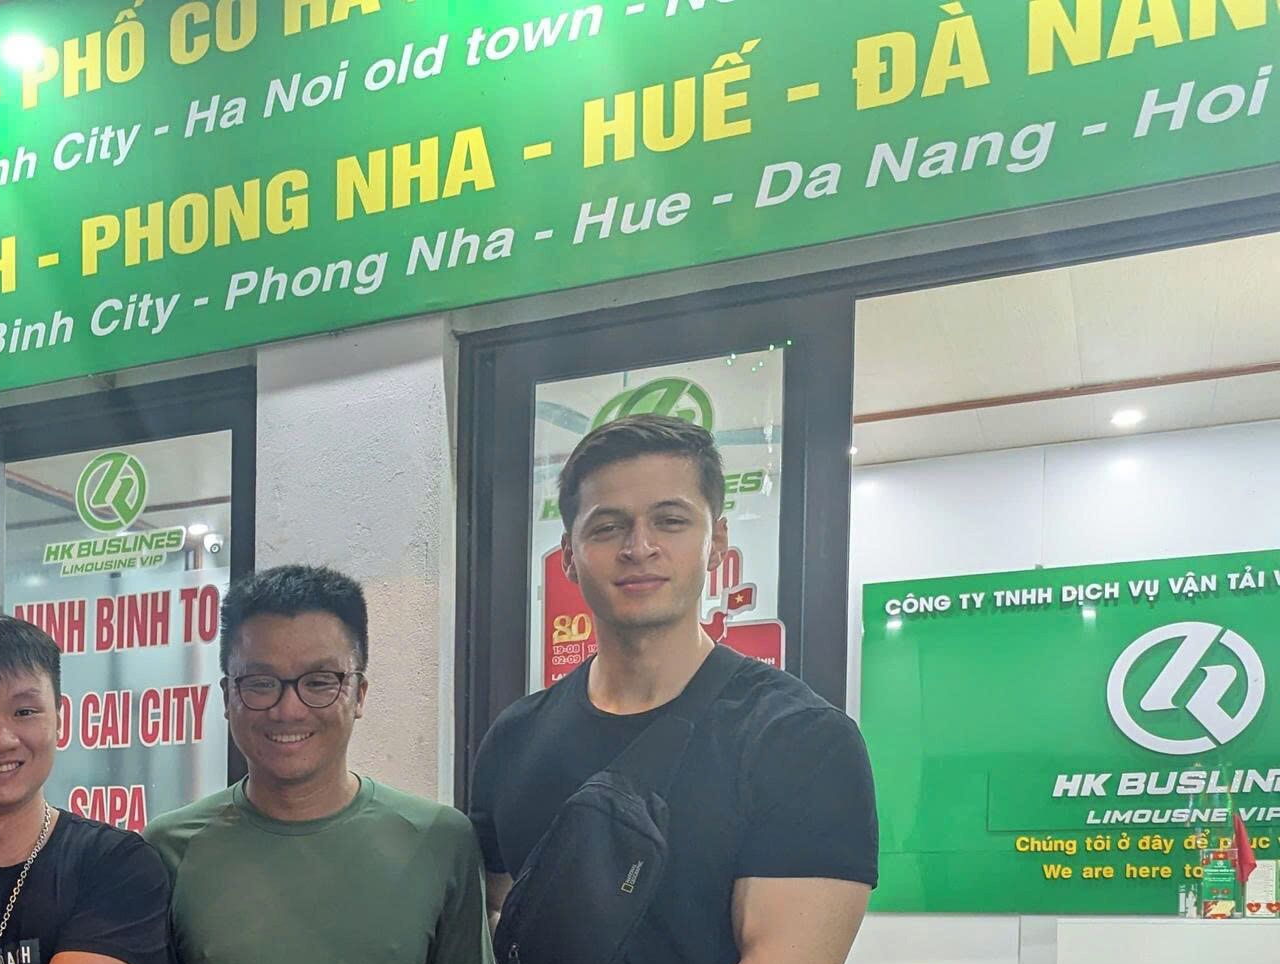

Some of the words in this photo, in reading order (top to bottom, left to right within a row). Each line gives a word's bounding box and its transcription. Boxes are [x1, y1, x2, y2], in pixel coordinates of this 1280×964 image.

[52, 122, 140, 176] City
[183, 95, 246, 138] Ha
[263, 68, 347, 119] Noi
[363, 42, 445, 88] old
[465, 4, 605, 63] town
[81, 169, 309, 276] PHONG
[335, 127, 495, 221] NHA
[583, 39, 761, 169] HUẾ
[852, 2, 990, 112] ĐÀ
[90, 290, 180, 345] City
[224, 249, 388, 312] Phong
[405, 227, 513, 277] Nha
[572, 190, 692, 247] Hue
[755, 159, 841, 209] Da
[864, 120, 1055, 190] Nang
[1133, 64, 1273, 138] Hoi
[44, 543, 74, 564] HK
[76, 527, 183, 558] BUSLINES
[61, 559, 136, 576] LIMOUSINE
[140, 554, 164, 567] VIP
[885, 590, 951, 616] CÔNG
[959, 592, 985, 611] TY
[994, 588, 1053, 608] TNHH
[1062, 581, 1120, 606] DỊCH
[1128, 579, 1160, 602] VỤ
[1227, 565, 1265, 590] TẢI
[14, 600, 86, 654] NINH
[95, 589, 170, 652] BINH
[180, 584, 221, 644] TO
[552, 613, 593, 645] 80
[78, 688, 132, 750] CAI
[137, 682, 212, 747] CITY
[1052, 773, 1112, 798] HK
[1015, 833, 1077, 854] Chúng
[1086, 834, 1111, 852] tôi
[1138, 834, 1173, 854] đây
[1043, 864, 1072, 880] We
[1082, 865, 1114, 879] are
[1125, 863, 1172, 878] here
[1184, 864, 1205, 878] to
